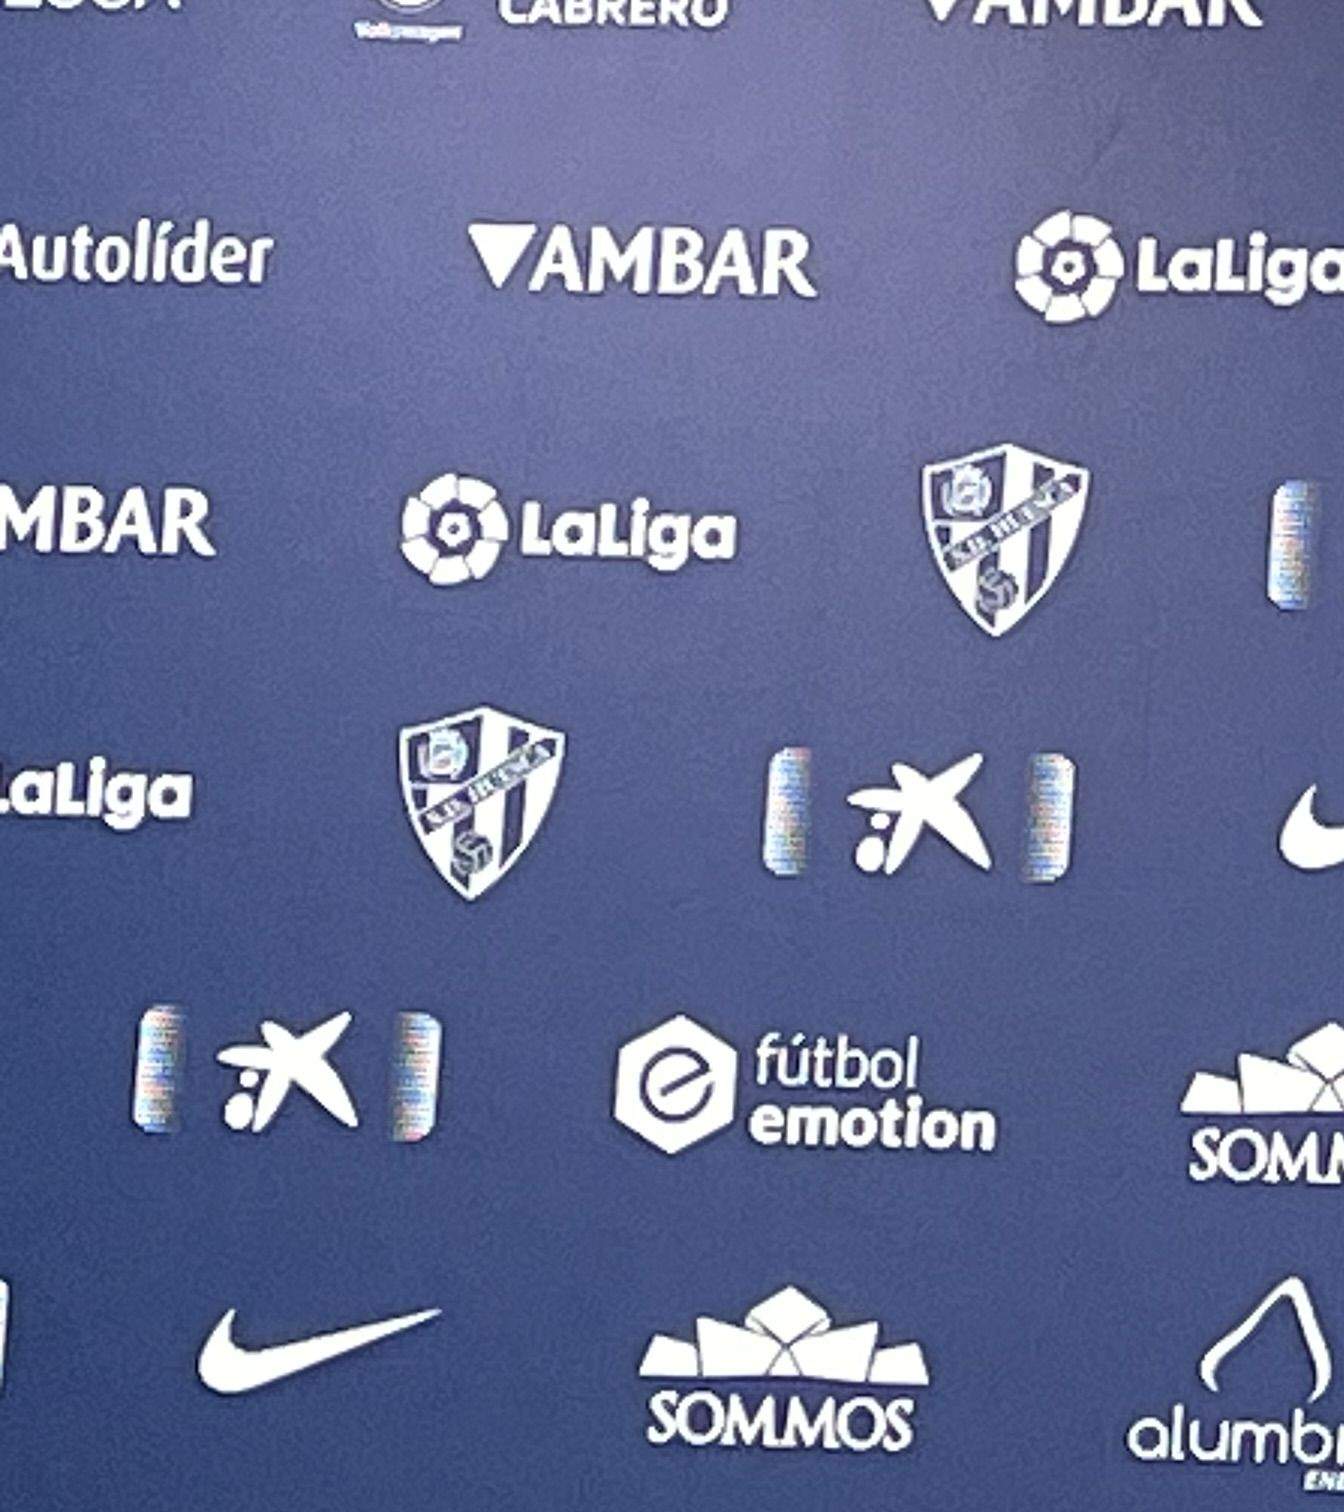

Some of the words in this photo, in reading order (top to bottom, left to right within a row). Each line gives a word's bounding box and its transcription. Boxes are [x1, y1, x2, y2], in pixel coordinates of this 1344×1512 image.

[0, 217, 274, 283] Autolíder
[528, 225, 817, 298] AMBAR
[521, 497, 737, 571] LaLiga
[756, 1032, 919, 1089] fútbol
[749, 1094, 996, 1151] emotion
[647, 1390, 914, 1452] SOMMOS
